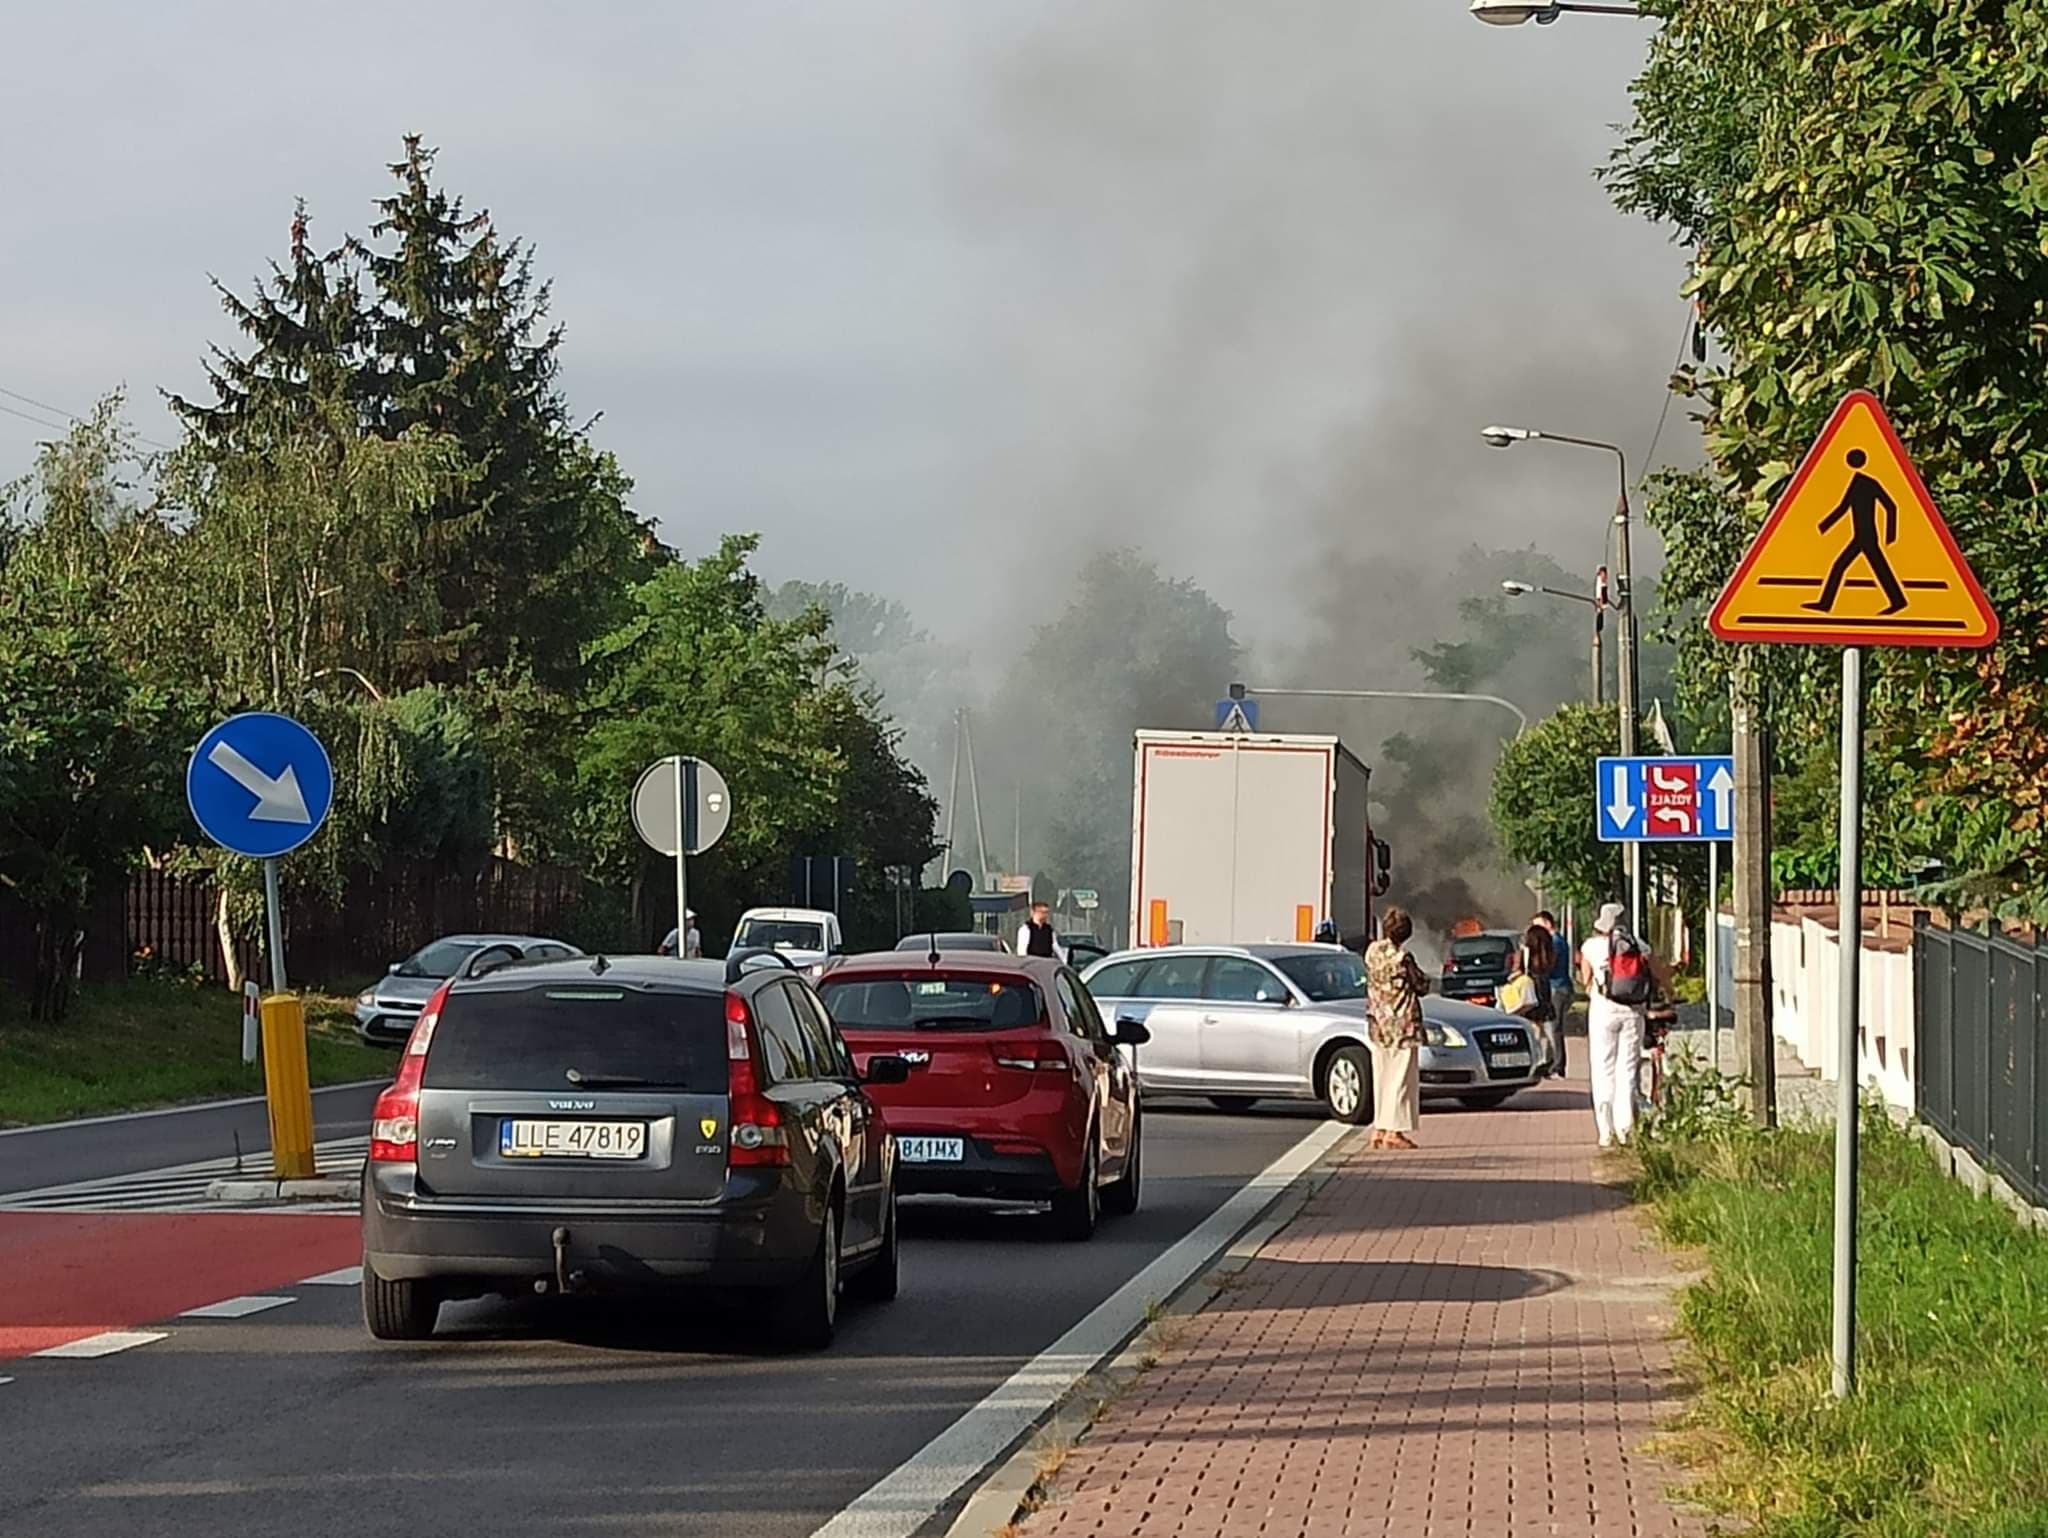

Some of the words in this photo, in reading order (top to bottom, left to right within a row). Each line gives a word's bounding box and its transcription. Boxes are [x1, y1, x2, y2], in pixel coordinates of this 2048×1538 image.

[548, 1100, 594, 1110] VOLVO
[515, 1123, 560, 1148] LLE
[569, 1125, 640, 1150] 47819
